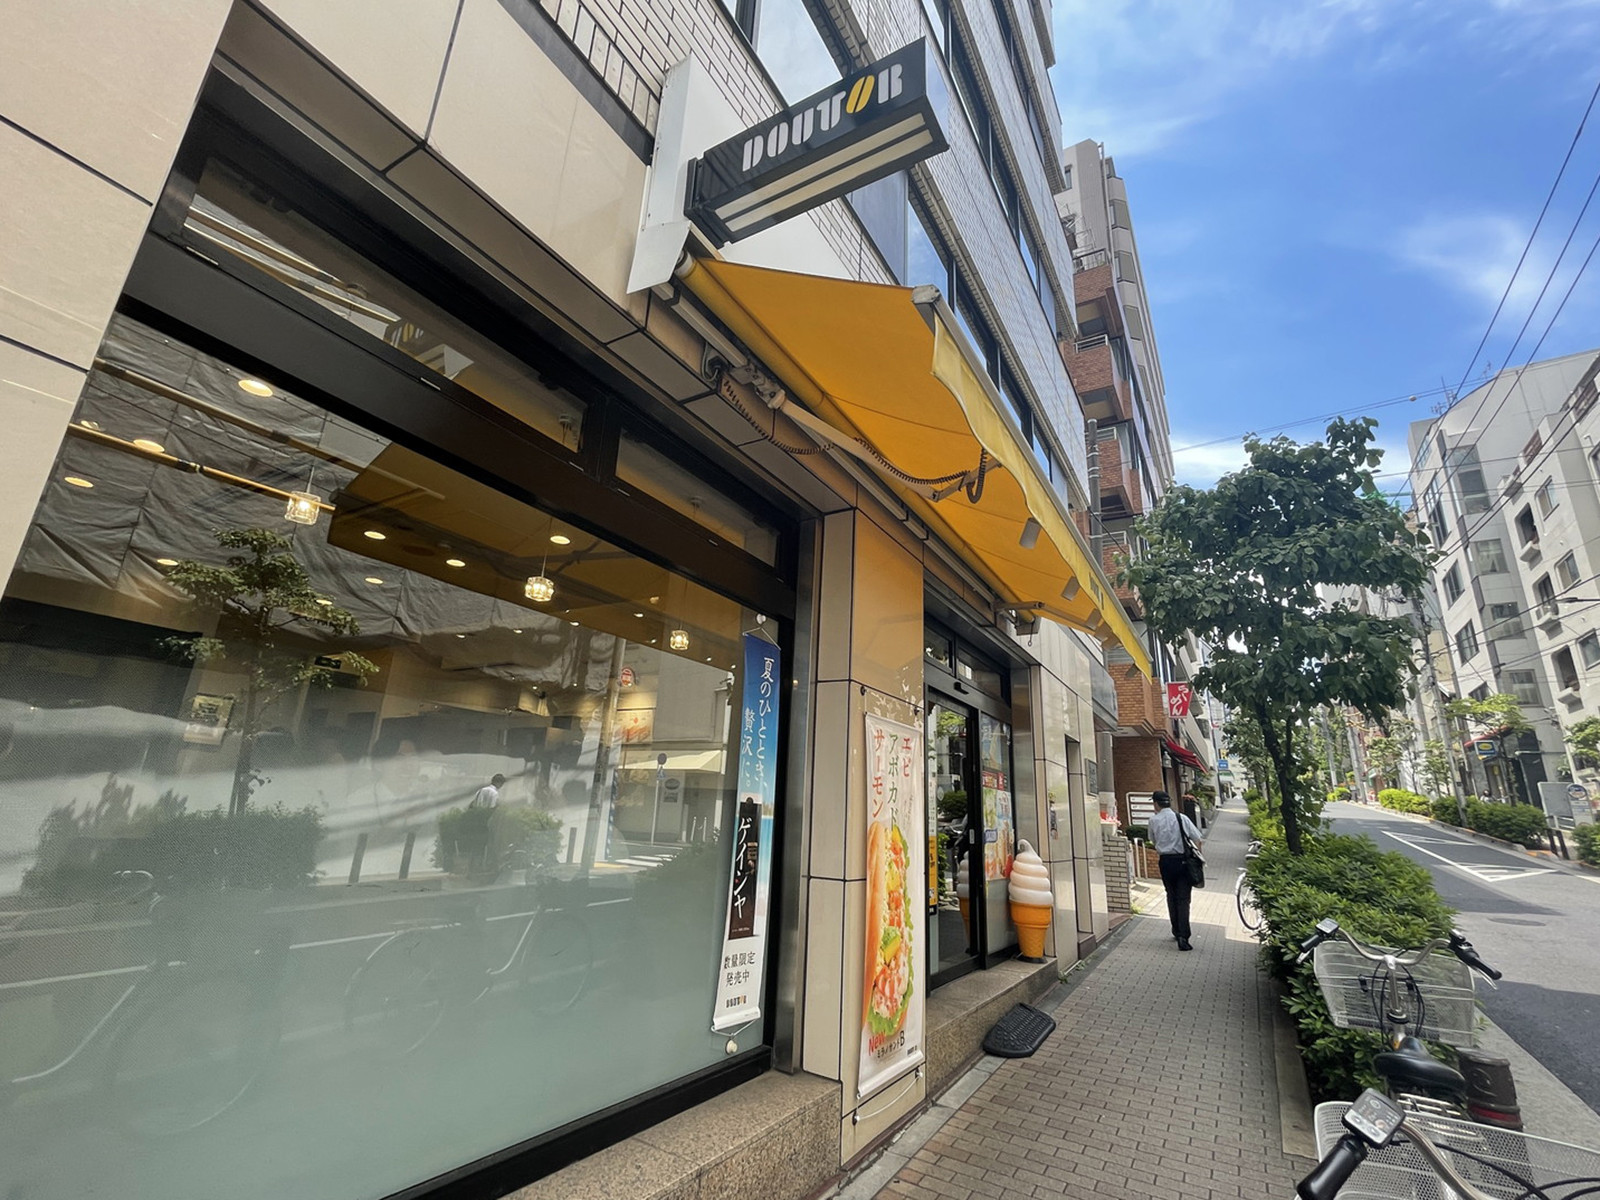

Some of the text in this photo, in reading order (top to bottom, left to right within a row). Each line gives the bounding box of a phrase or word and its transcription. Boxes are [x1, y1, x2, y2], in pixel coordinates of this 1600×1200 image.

[742, 63, 903, 172] DOUTOR
[1170, 684, 1189, 715] らーめん
[872, 728, 885, 818] サーモン
[902, 738, 912, 778] エビ
[888, 733, 899, 832] アボカド
[724, 951, 756, 970] 数量限定
[726, 969, 750, 988] 発売中
